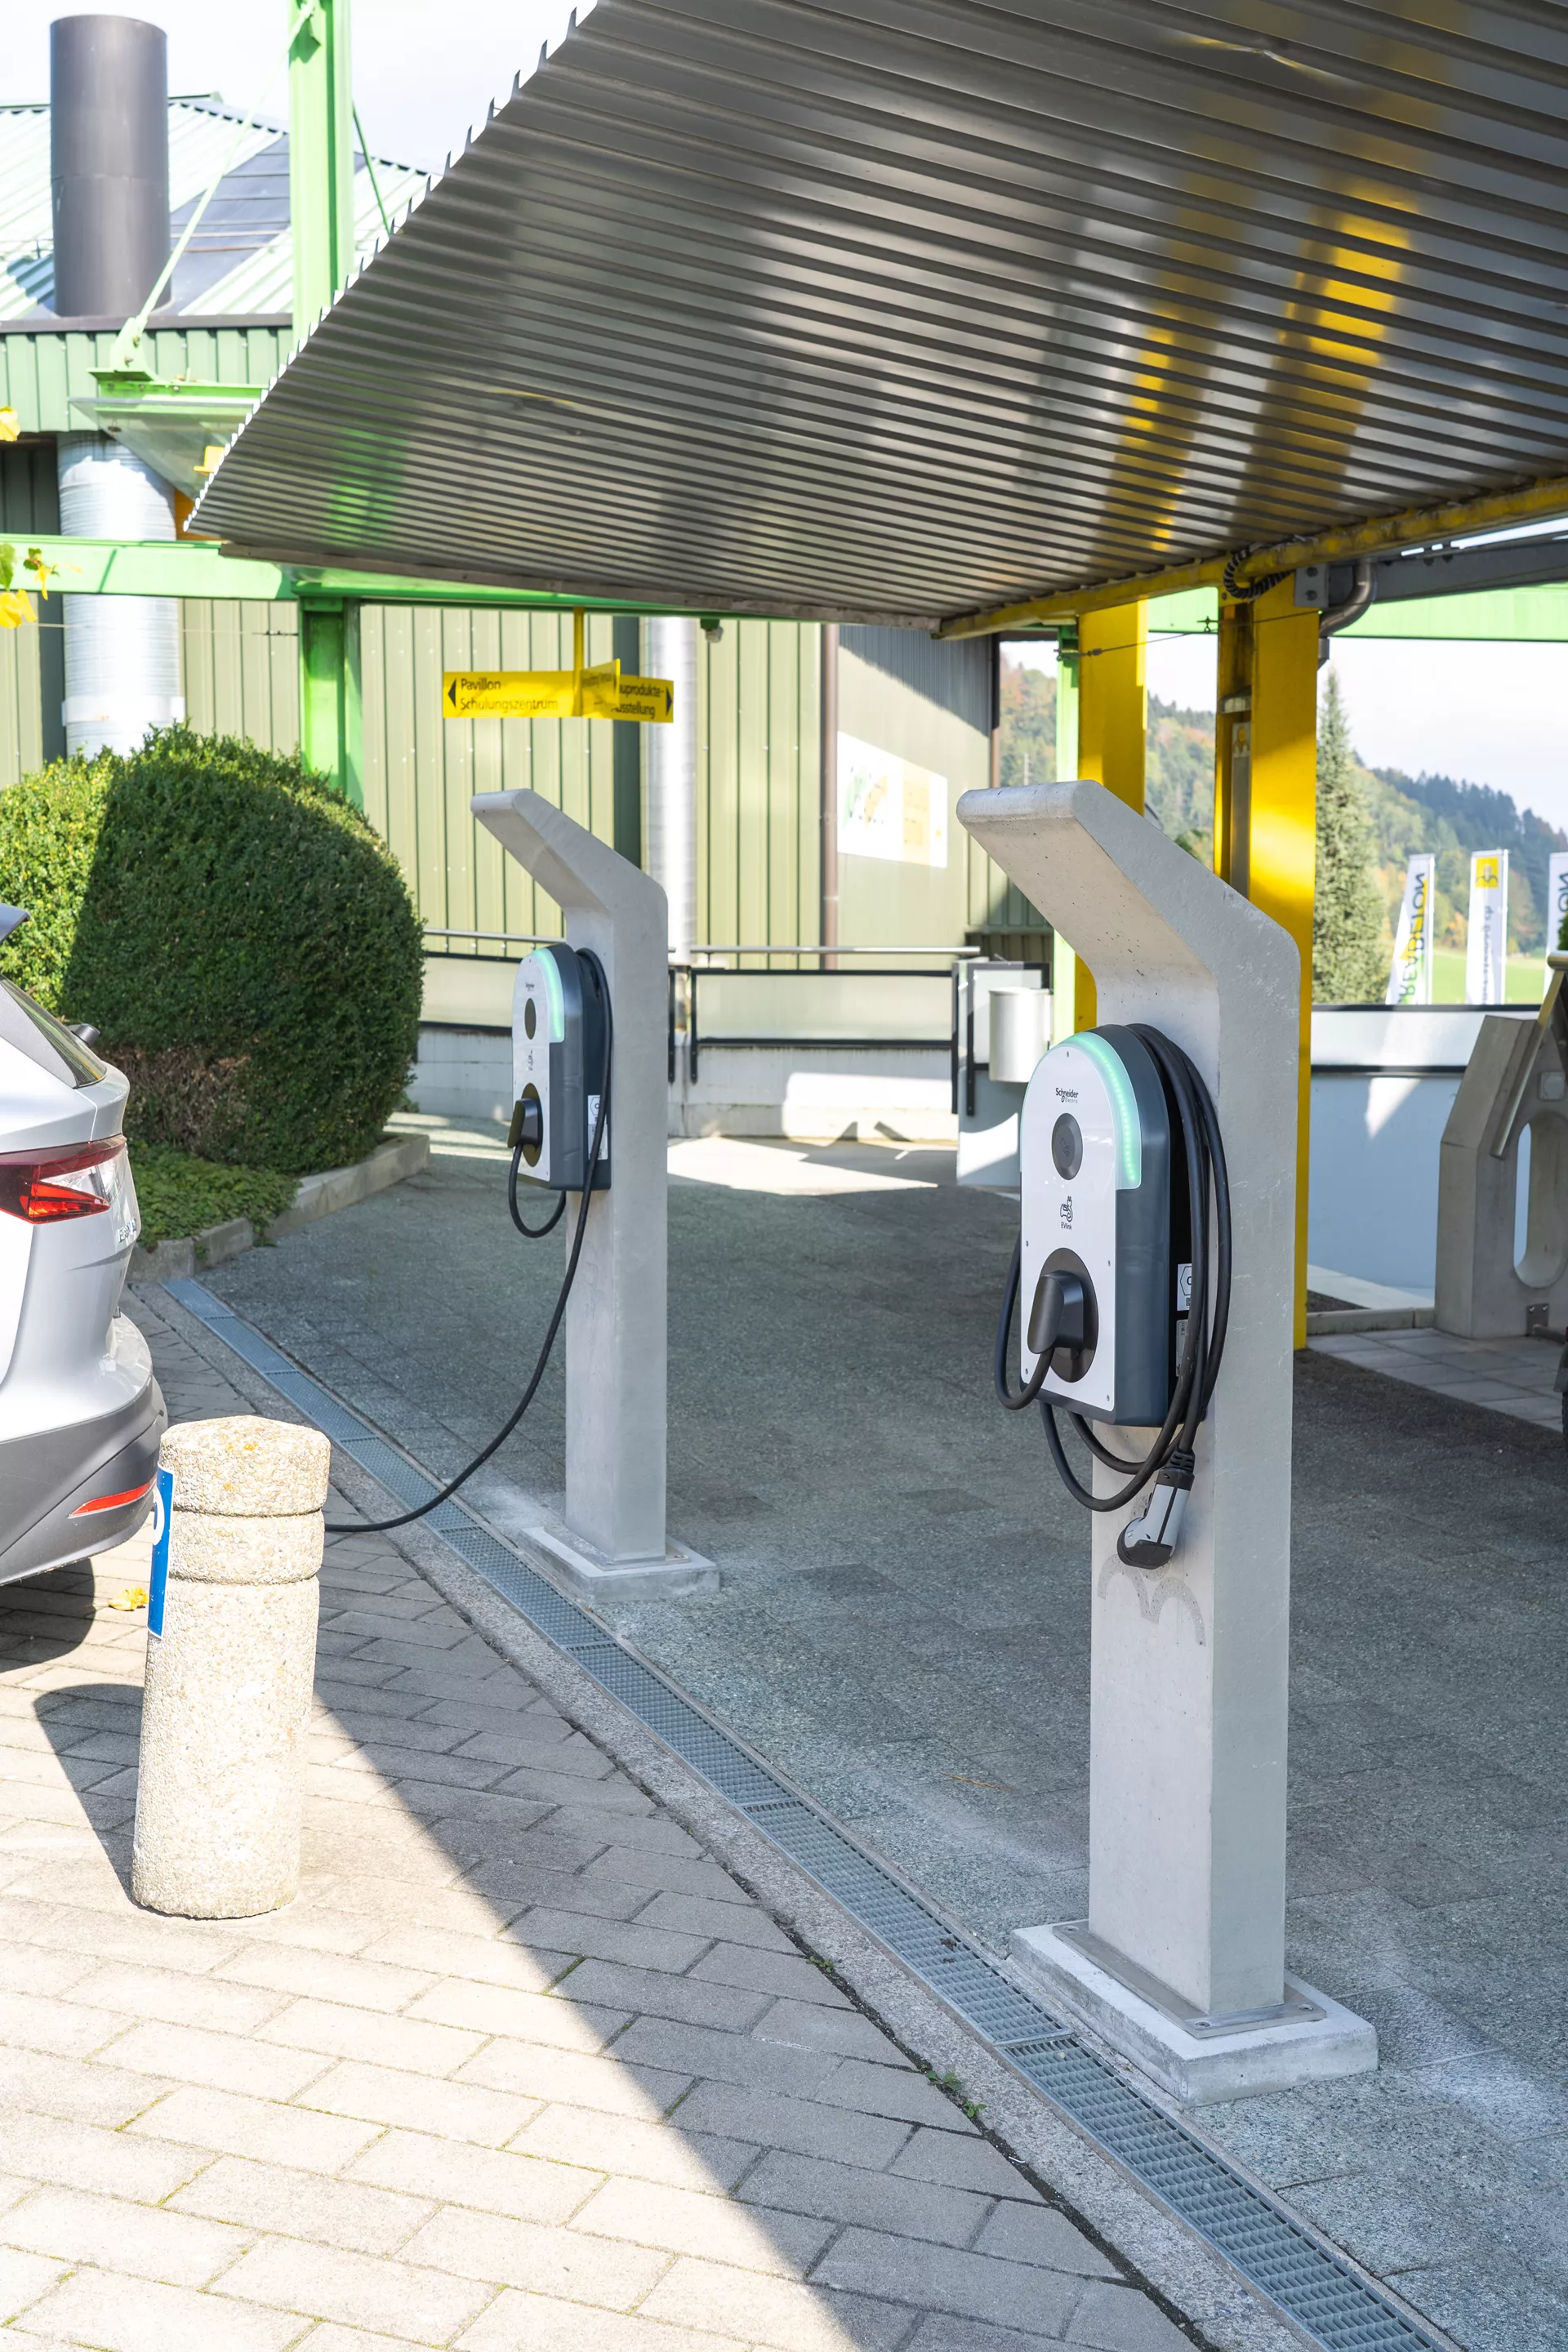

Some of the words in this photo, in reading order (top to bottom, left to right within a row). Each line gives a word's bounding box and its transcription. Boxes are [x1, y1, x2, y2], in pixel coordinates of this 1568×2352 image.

[461, 678, 501, 690] Pavillon
[619, 683, 664, 697] uprodukte-
[460, 697, 558, 713] Schulungszentrum
[1055, 1087, 1079, 1098] Schneider
